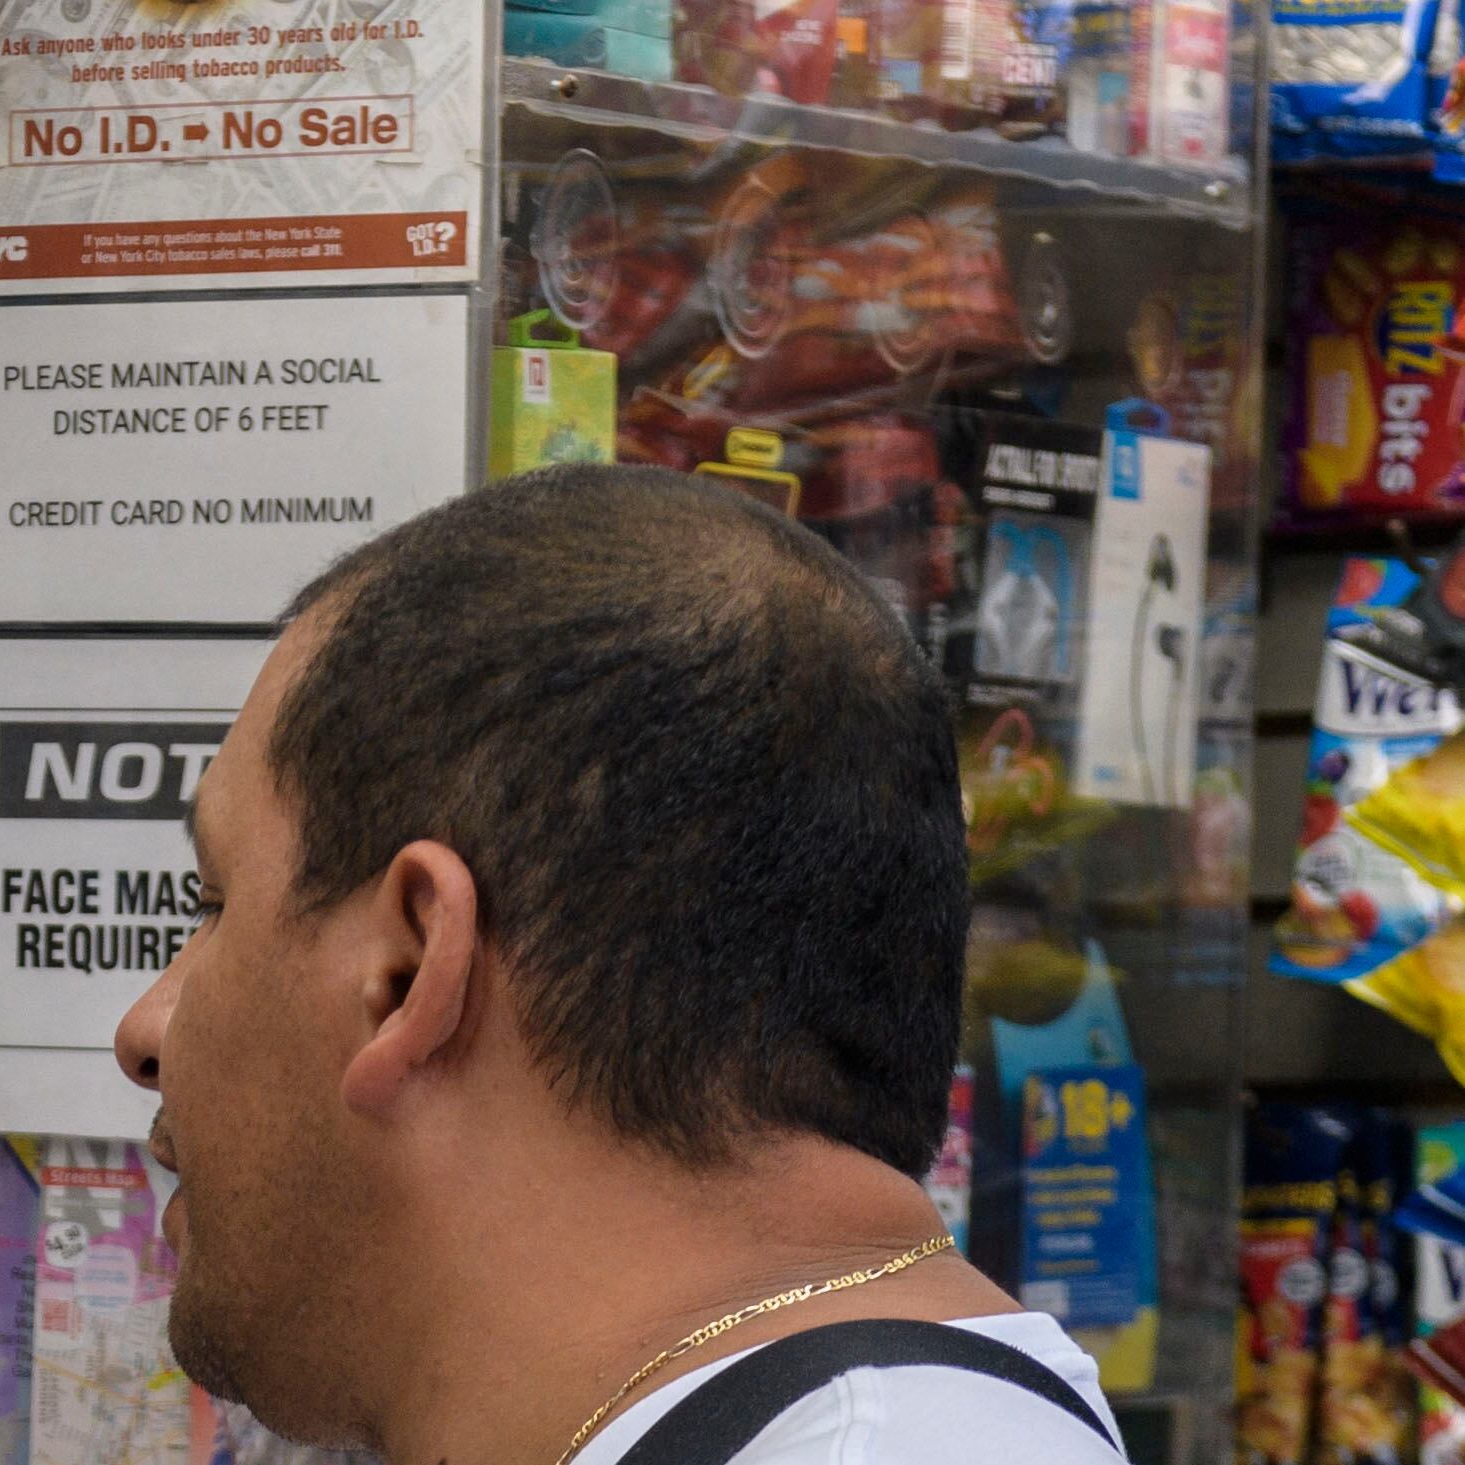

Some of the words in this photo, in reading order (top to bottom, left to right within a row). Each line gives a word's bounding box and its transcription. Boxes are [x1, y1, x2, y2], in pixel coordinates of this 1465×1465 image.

[1, 37, 31, 56] Ask
[37, 35, 95, 58] anyone
[101, 32, 134, 52] who
[141, 30, 185, 51] looks
[192, 28, 240, 49] under
[247, 26, 271, 47] 30
[277, 25, 325, 49] years
[330, 23, 356, 43] old
[361, 21, 388, 42] for
[394, 19, 425, 40] I.D.
[71, 63, 125, 84] before
[131, 60, 186, 83] selling
[192, 58, 259, 80] tobacco
[265, 55, 347, 81] products.
[23, 118, 84, 158] No
[99, 113, 171, 155] I.D.
[222, 110, 284, 150] No
[298, 105, 400, 147] Sale
[3, 363, 103, 391] PLEASE
[110, 359, 247, 389] MAINTAIN
[253, 360, 275, 386] A
[280, 357, 382, 385] SOCIAL
[52, 406, 187, 436] DISTANCE
[195, 406, 231, 434] OF
[238, 405, 254, 433] 6
[262, 404, 329, 431] FEET
[1377, 383, 1433, 497] bits
[8, 500, 102, 528] CREDIT
[110, 499, 184, 526] CARD
[192, 498, 232, 525] NO
[240, 496, 375, 524] MINIMUM
[24, 741, 223, 802] NOT
[1, 869, 100, 916] FACE
[115, 871, 204, 917] MAS
[17, 922, 200, 975] REQUIRE
